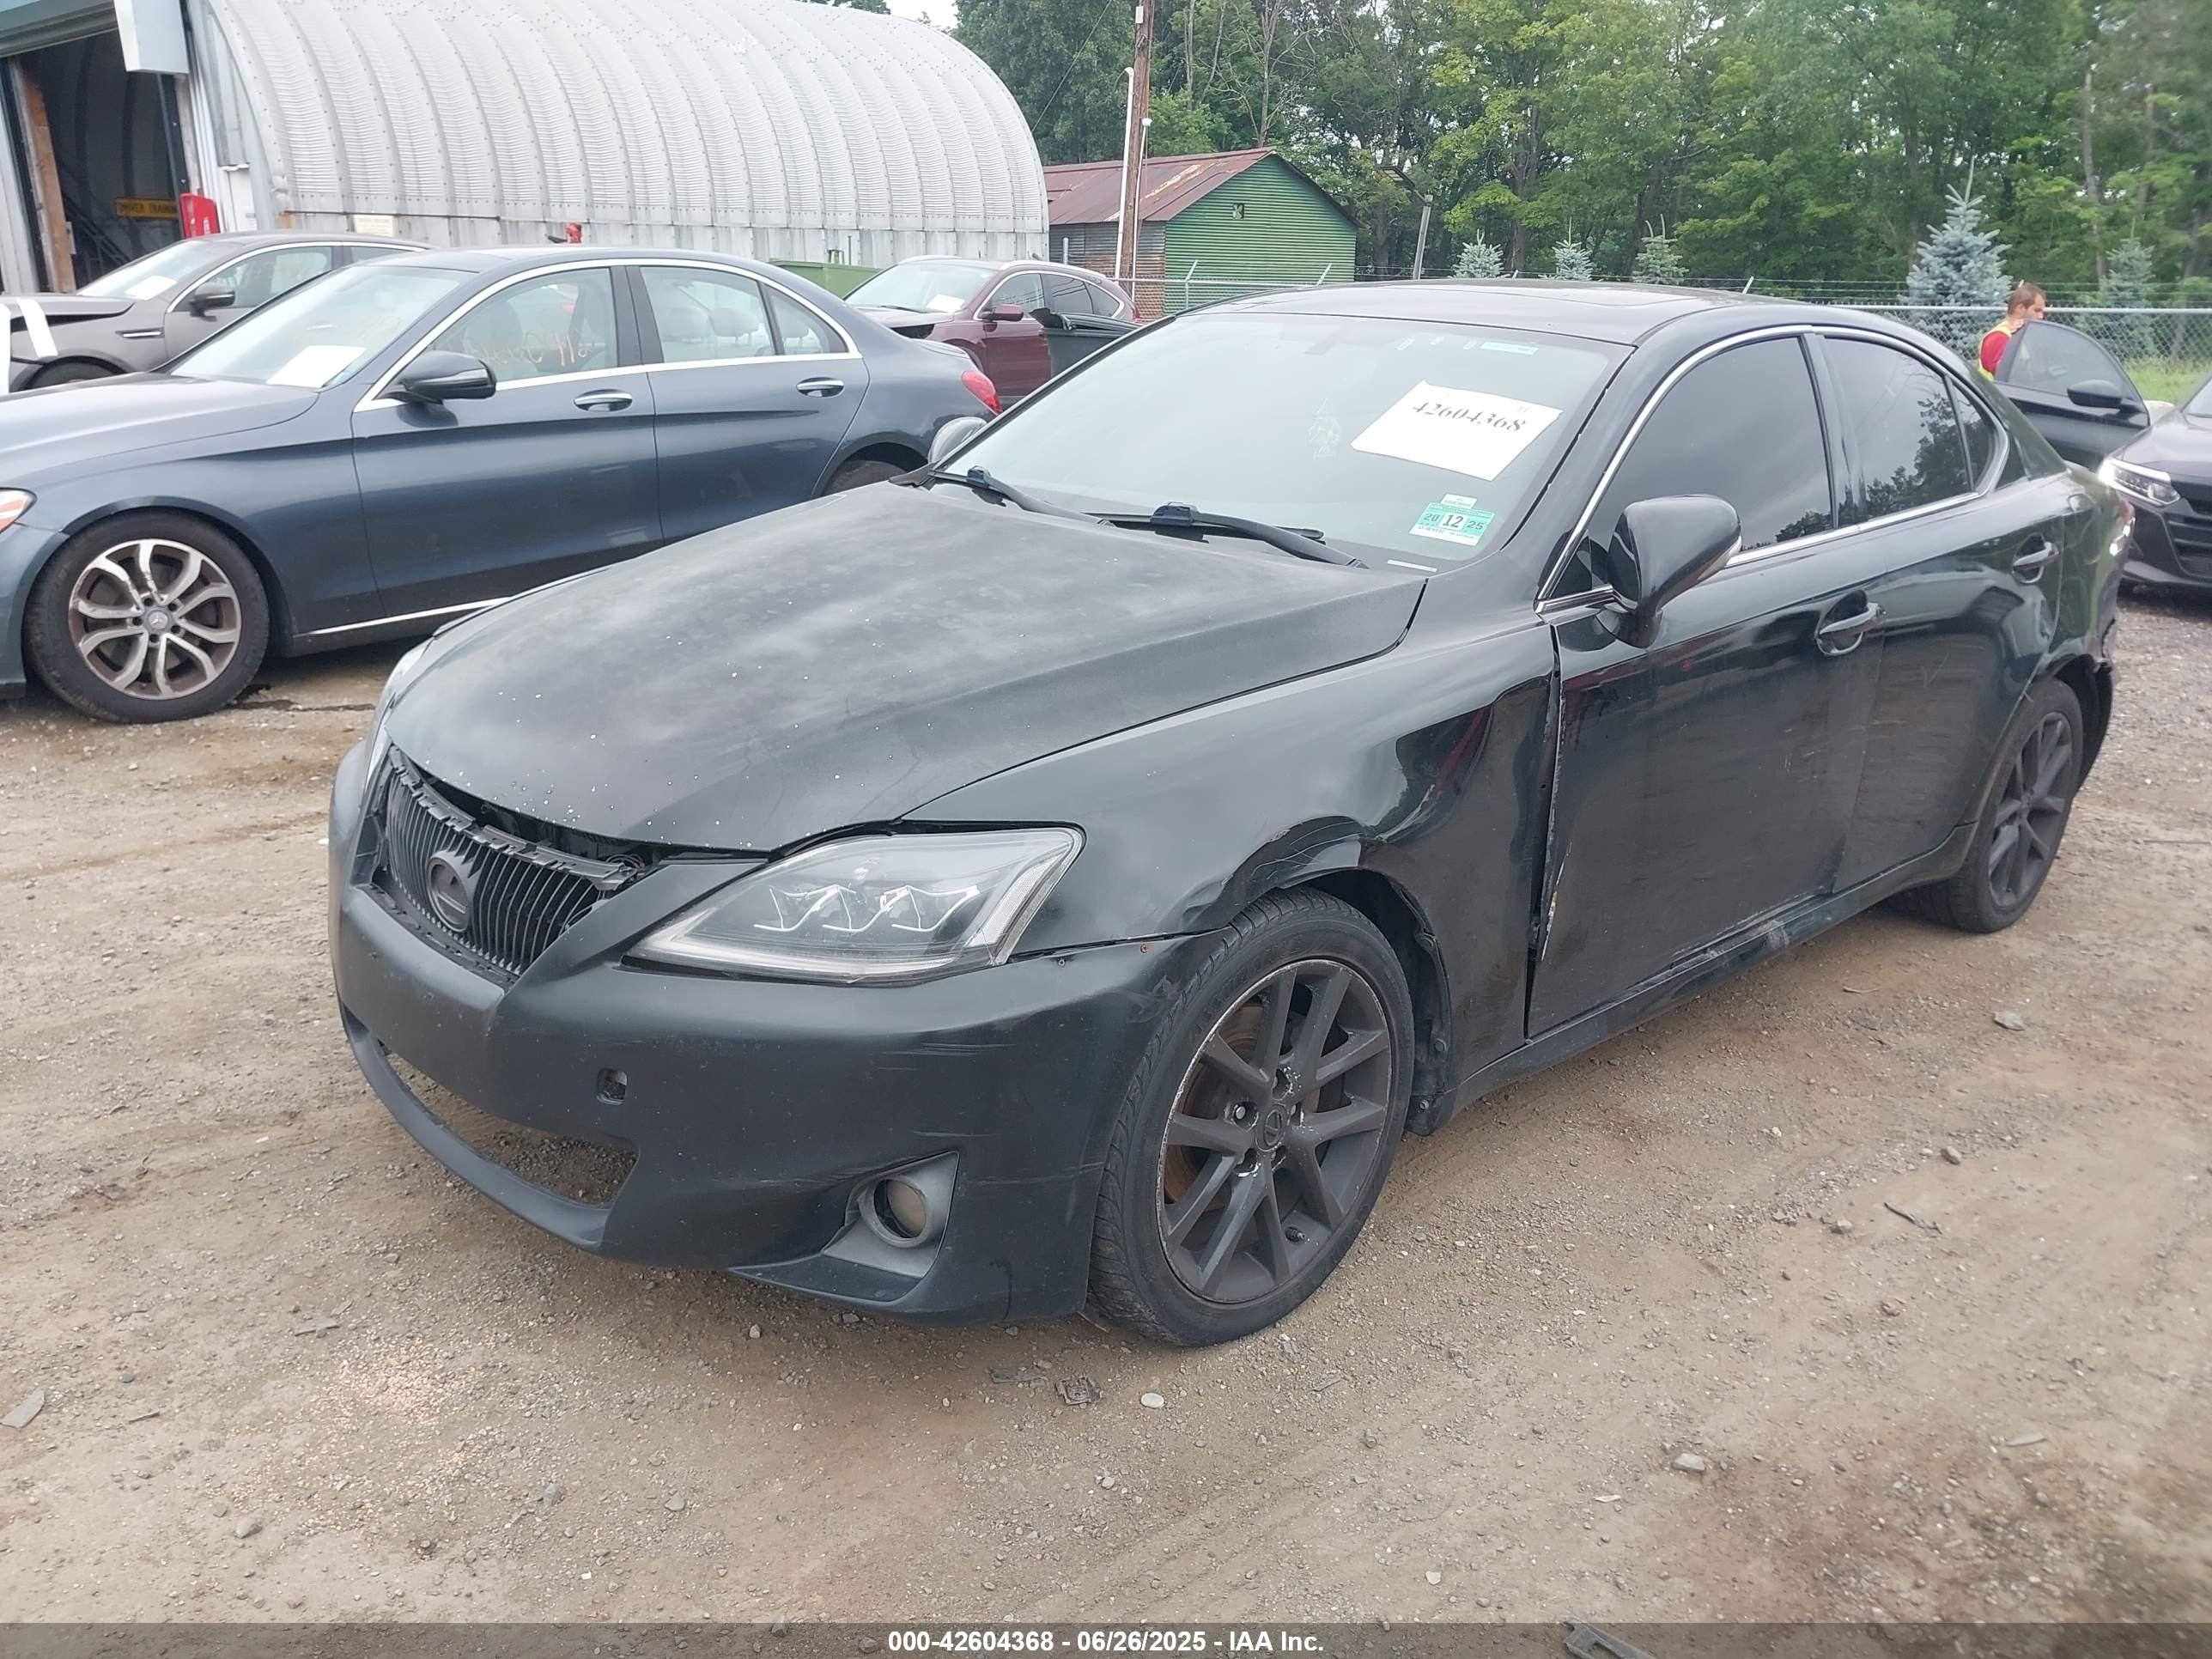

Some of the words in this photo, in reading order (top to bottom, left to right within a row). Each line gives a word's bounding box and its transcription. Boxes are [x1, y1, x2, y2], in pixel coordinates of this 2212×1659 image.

[1412, 401, 1527, 431] 42604368
[1424, 513, 1440, 522] 20
[1443, 514, 1464, 528] 12
[1467, 520, 1485, 531] 25
